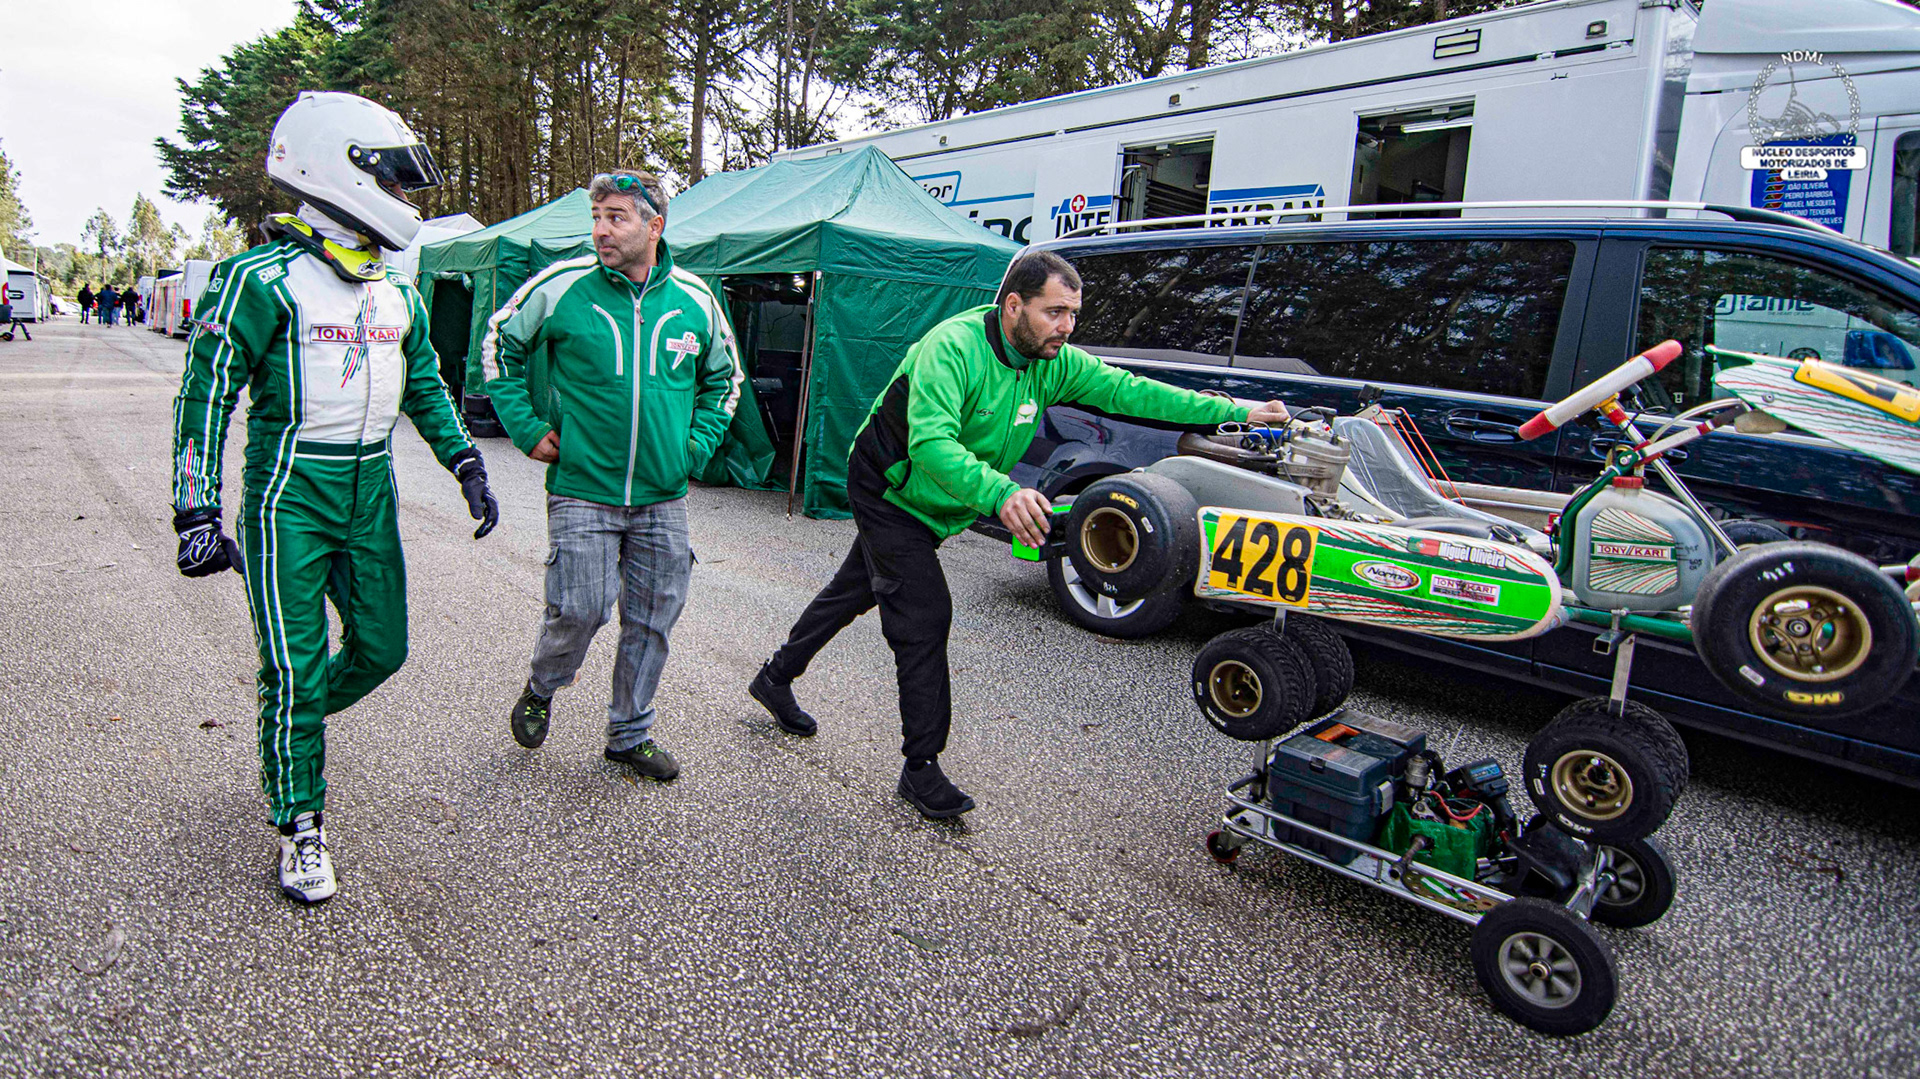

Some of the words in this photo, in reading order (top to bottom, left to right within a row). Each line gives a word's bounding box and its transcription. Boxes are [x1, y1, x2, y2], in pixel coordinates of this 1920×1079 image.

[1802, 182, 1829, 190] OLIVEIRA
[1785, 191, 1804, 199] PEDRO
[1805, 190, 1833, 198] BARBOSA
[1784, 200, 1804, 208] MIGUEL
[1805, 199, 1836, 207] MESQUITA
[1809, 208, 1836, 216] TEIXEIRA
[258, 265, 284, 282] OMP
[317, 327, 356, 339] TONY
[368, 328, 400, 340] KART
[1438, 541, 1471, 562] Miguel
[1470, 547, 1506, 568] Oliveira
[1599, 544, 1628, 555] TONY
[1634, 547, 1665, 557] KART
[1211, 516, 1312, 602] 428
